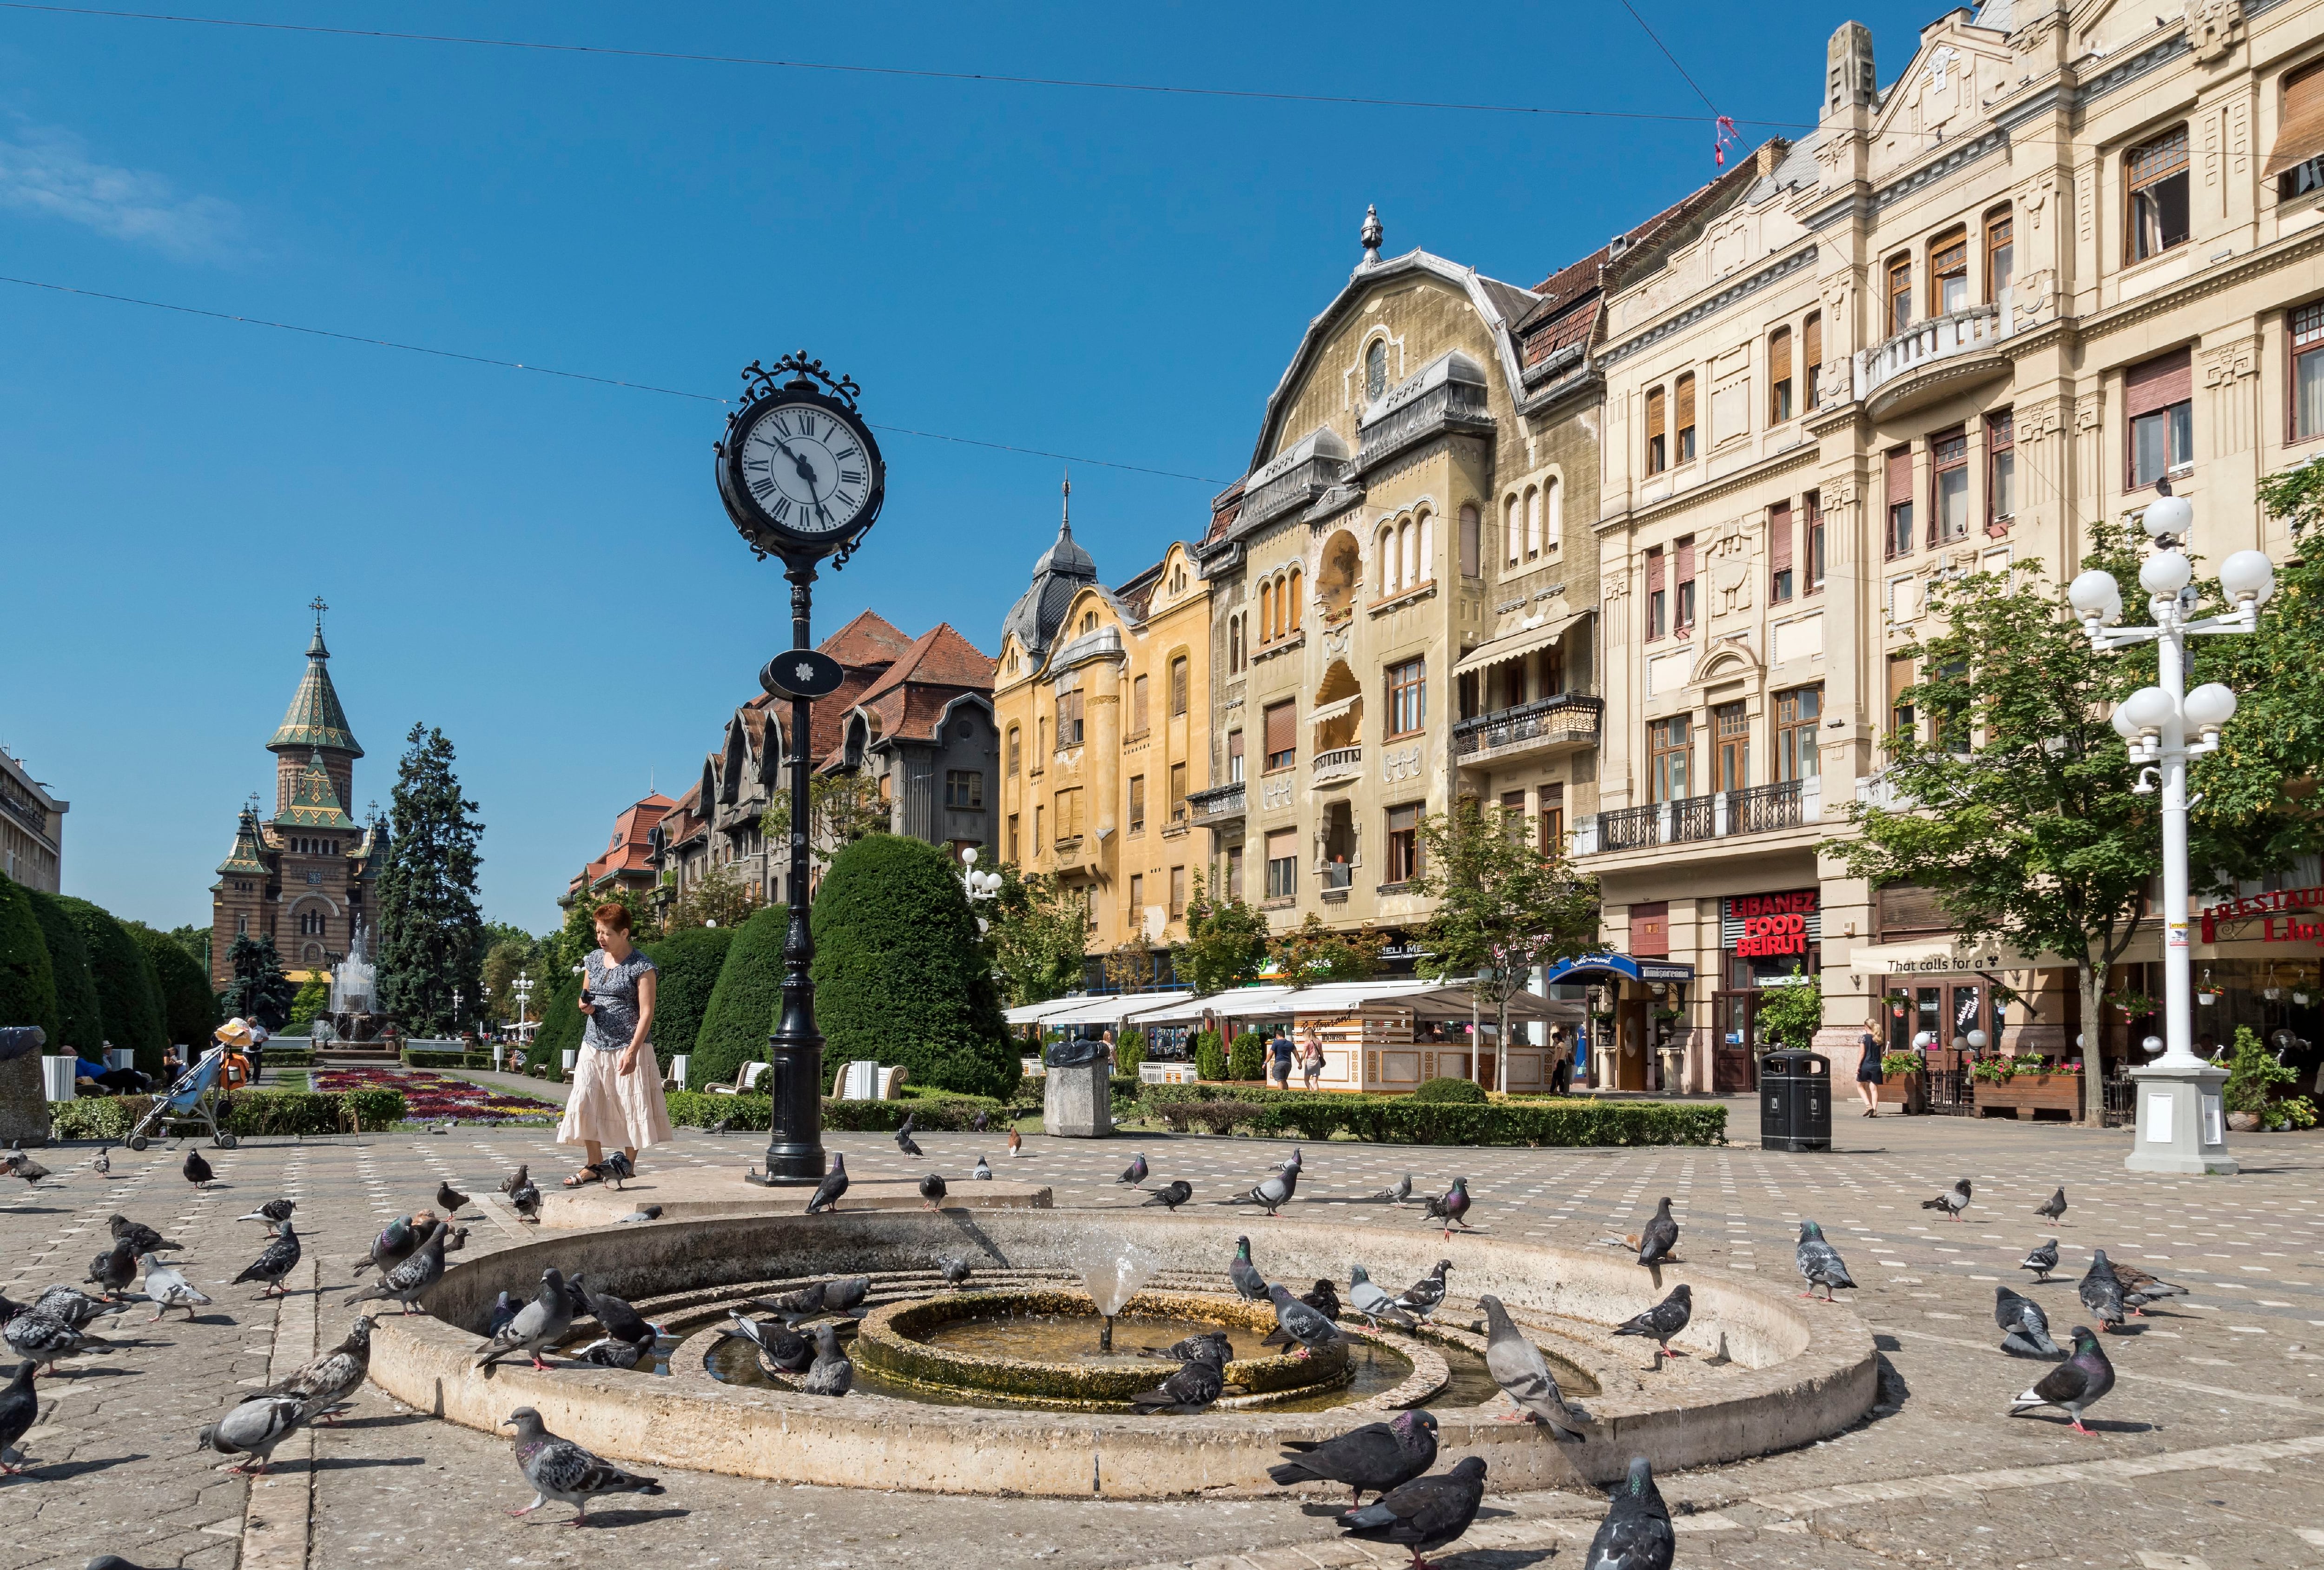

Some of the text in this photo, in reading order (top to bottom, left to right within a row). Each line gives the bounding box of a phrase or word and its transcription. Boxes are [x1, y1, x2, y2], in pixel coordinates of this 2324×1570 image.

[772, 417, 791, 440] XI
[798, 414, 814, 436] XII
[823, 426, 835, 443] I
[754, 433, 775, 451] X
[748, 457, 769, 472] IX
[835, 447, 856, 461] II
[842, 470, 861, 484] III
[752, 477, 777, 501] VIII
[835, 489, 856, 510] IV
[771, 496, 792, 520] VII
[799, 506, 810, 527] VI
[823, 504, 835, 524] V
[1731, 892, 1815, 917] LIBANEZ
[2216, 887, 2324, 922] RESTAU
[1745, 914, 1805, 937] FOOD
[1736, 933, 1807, 957] BEIRUT
[1888, 957, 1982, 971] That calls for a
